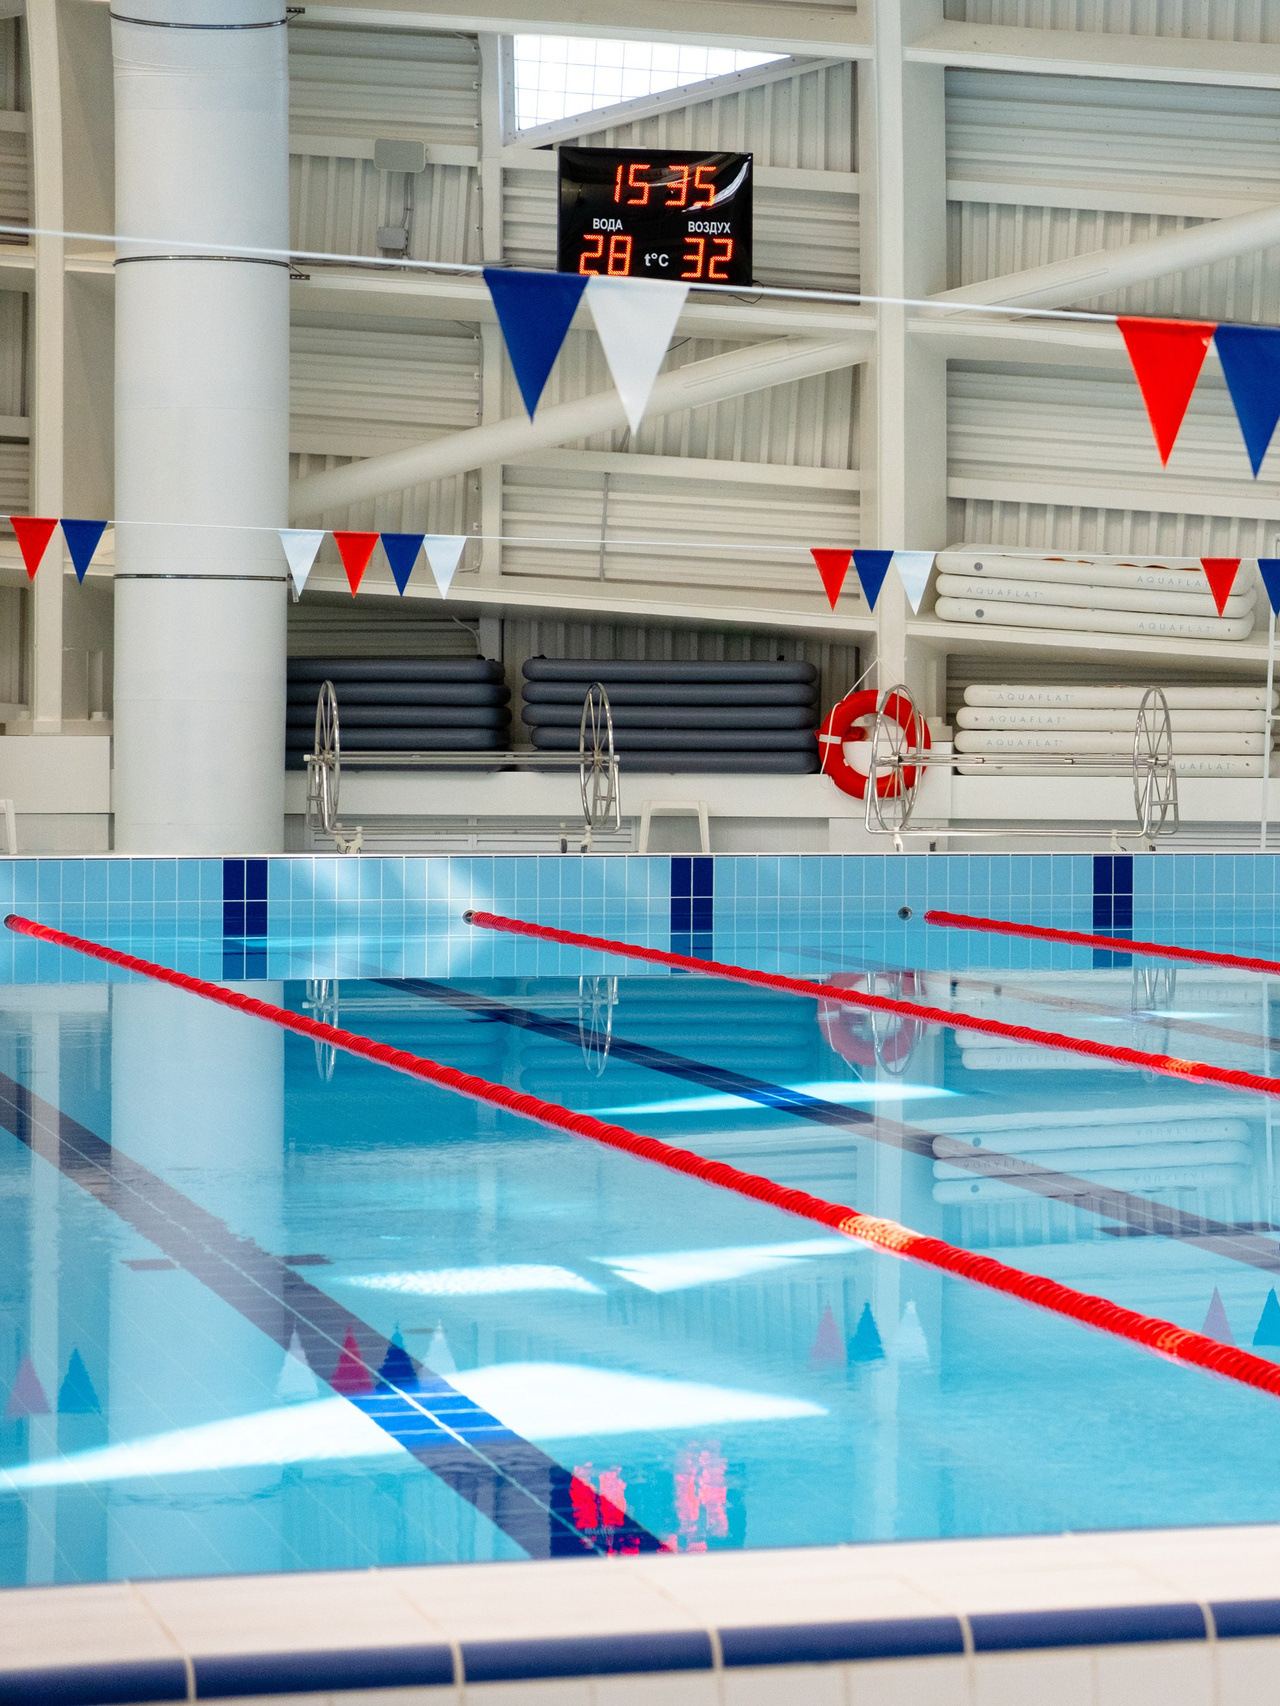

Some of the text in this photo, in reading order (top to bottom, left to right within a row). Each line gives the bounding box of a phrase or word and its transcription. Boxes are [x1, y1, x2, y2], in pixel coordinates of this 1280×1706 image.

[613, 164, 717, 206] 15 35
[593, 218, 623, 232] ВОДА
[688, 221, 731, 235] ВОЗДУХ
[579, 234, 633, 276] 28
[681, 237, 733, 279] 32
